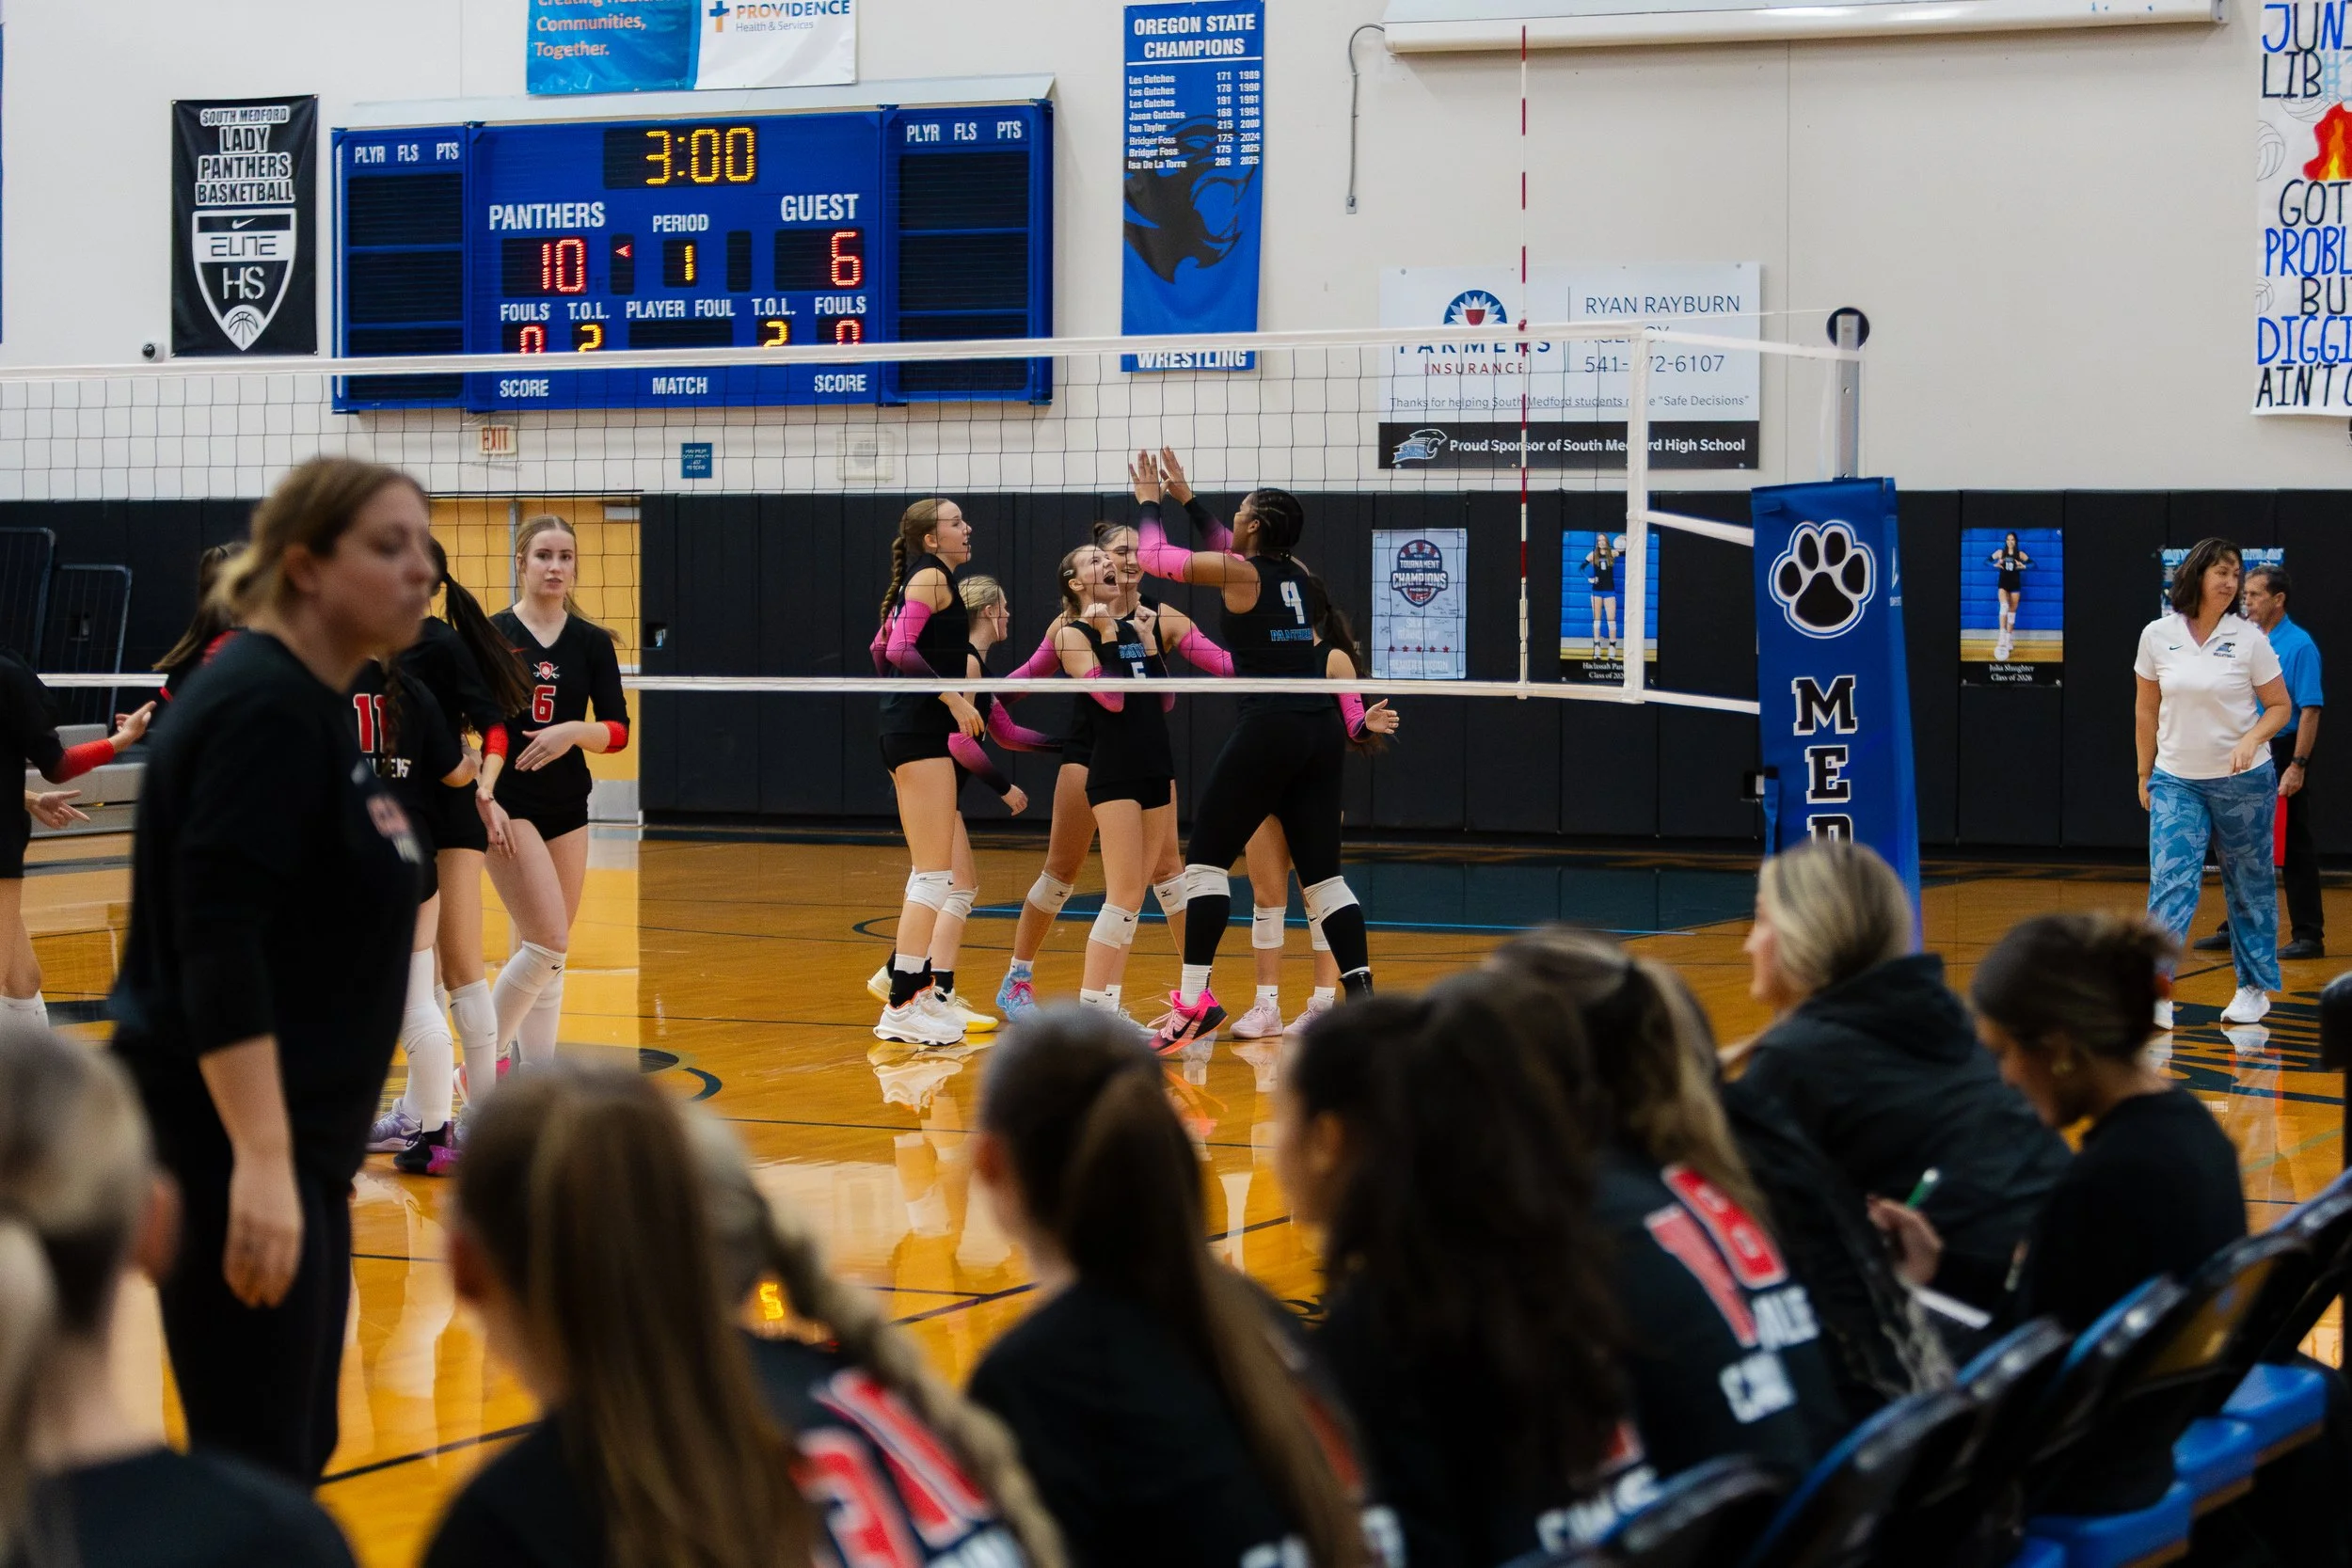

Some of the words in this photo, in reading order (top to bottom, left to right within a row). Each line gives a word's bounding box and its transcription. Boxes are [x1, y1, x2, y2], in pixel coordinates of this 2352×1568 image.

[736, 0, 850, 20] PROVIDENCE
[536, 13, 647, 32] Communities,
[736, 21, 767, 33] Health
[768, 22, 775, 32] &
[777, 21, 814, 31] Services
[1134, 16, 1201, 36] OREGON
[1206, 13, 1256, 33] STATE
[534, 40, 611, 61] Together.
[1143, 38, 1246, 59] CHAMPIONS
[1129, 75, 1143, 86] Les
[1144, 74, 1176, 85] Gutches
[1216, 71, 1232, 81] 171
[1239, 71, 1261, 80] 1989
[2262, 51, 2322, 98] LIB
[1129, 87, 1143, 97] Les
[1144, 87, 1176, 97] Gutches
[1239, 83, 1261, 92] 1990
[1129, 100, 1143, 109] Les
[1144, 99, 1176, 109] Gutches
[1216, 96, 1232, 105] 191
[1239, 95, 1260, 104] 1991
[201, 109, 237, 125] SOUTH
[239, 106, 290, 124] MEDFORD
[1129, 112, 1152, 121] Jason
[1153, 110, 1185, 120] Gutches
[1240, 107, 1260, 117] 1994
[907, 123, 941, 143] PLYR
[954, 121, 977, 141] FLS
[996, 119, 1023, 139] PTS
[1129, 124, 1142, 134] Ian
[1143, 123, 1167, 135] Taylor
[1217, 120, 1233, 130] 215
[1240, 119, 1260, 129] 2000
[219, 126, 271, 153] LADY
[1130, 136, 1158, 147] Bridger
[1158, 135, 1177, 145] Foss
[1217, 134, 1233, 143] 175
[1240, 133, 1261, 142] 2024
[355, 145, 386, 164] PLYR
[398, 143, 420, 162] FLS
[436, 142, 460, 160] PTS
[646, 127, 755, 185] 3:00
[1129, 148, 1158, 158] Bridger
[1159, 148, 1179, 156] Foss
[1216, 145, 1232, 154] 175
[1240, 144, 1260, 153] 2025
[198, 152, 292, 182] PANTHERS
[1128, 160, 1141, 169] Isa
[1142, 160, 1153, 169] De
[1154, 159, 1165, 168] La
[1166, 159, 1187, 168] Torre
[1240, 156, 1260, 166] 2025
[195, 179, 295, 206] BASKETBALL
[780, 193, 860, 222] GUEST
[2279, 179, 2352, 227] GOT
[489, 200, 606, 230] PANTHERS
[653, 213, 710, 233] PERIOD
[210, 235, 277, 257] ELITE
[2265, 226, 2352, 277] PROBL
[542, 239, 584, 293] 10
[685, 245, 694, 281] 1
[831, 231, 862, 287] 6
[222, 266, 266, 300] HS
[500, 302, 550, 322] FOULS
[566, 301, 610, 321] T.O.L.
[626, 299, 686, 319] PLAYER
[694, 298, 737, 318] FOUL
[752, 296, 796, 317] T.O.L.
[815, 295, 867, 316] FOULS
[1585, 296, 1637, 314] RYAN
[1645, 294, 1740, 313] RAYBURN
[1136, 350, 1248, 369] WRESTLING
[1424, 361, 1523, 374] INSURANCE
[1584, 354, 1725, 373] 541-72-6107
[500, 378, 549, 398] SCORE
[652, 376, 708, 395] MATCH
[814, 373, 867, 393] SCORE
[2255, 362, 2338, 408] AIN'T
[1391, 397, 1428, 408] Thanks
[1431, 396, 1445, 407] for
[1449, 396, 1489, 409] helping
[1494, 395, 1522, 407] South
[1526, 395, 1570, 407] Medford
[1575, 395, 1623, 406] students
[1658, 395, 1688, 406] “Safe
[1691, 394, 1750, 406] Decisions”
[482, 427, 508, 451] EXIT
[1450, 439, 1487, 452] Proud
[1490, 439, 1545, 454] Sponsor
[1548, 438, 1562, 451] of
[1563, 438, 1602, 451] South
[1664, 438, 1697, 454] High
[1699, 437, 1745, 451] School
[1399, 560, 1440, 569] TOURNAMENT
[1392, 572, 1448, 589] CHAMPIONS
[1280, 581, 1305, 625] 9
[1605, 671, 1613, 679] of
[532, 685, 557, 723] 6
